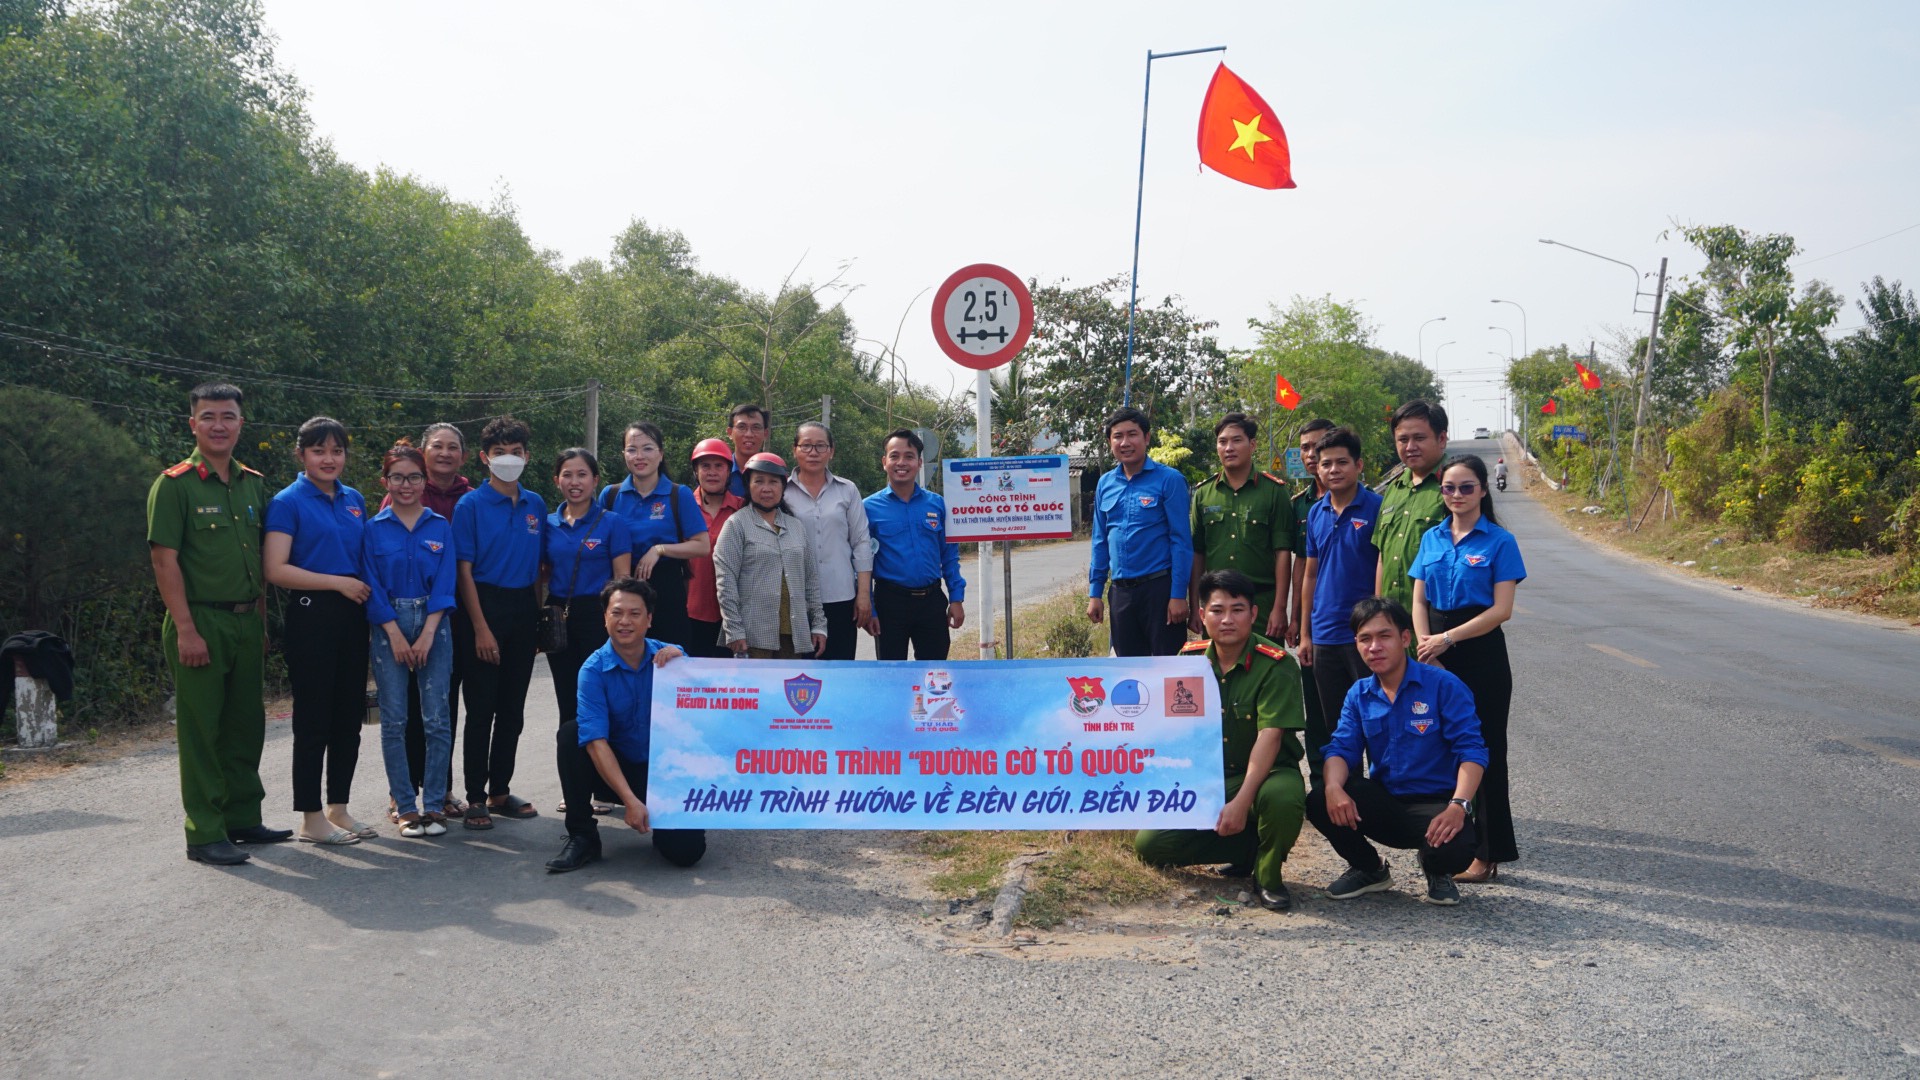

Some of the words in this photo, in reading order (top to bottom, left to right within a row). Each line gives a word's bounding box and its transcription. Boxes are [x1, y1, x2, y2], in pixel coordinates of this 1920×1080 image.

[979, 494, 1006, 503] CÔNG
[1010, 492, 1036, 501] TRÌNH
[952, 504, 992, 514] ĐƯỜNG
[997, 504, 1011, 513] CỜ
[1015, 502, 1028, 512] TỔ
[1033, 501, 1063, 511] QUỐC
[676, 697, 707, 709] NGƯỜI
[710, 698, 729, 710] LAO
[732, 698, 758, 710] ĐỘNG
[1084, 722, 1101, 731] TỈNH
[1104, 720, 1118, 731] BẾN
[1121, 722, 1134, 731] TRE
[736, 748, 827, 775] CHƯƠNG
[836, 747, 901, 775] TRÌNH
[1006, 746, 1037, 775] CỜ
[1044, 742, 1073, 775] TỔ
[683, 784, 752, 813] HÀNH
[760, 786, 830, 814] TRÌNH
[835, 786, 918, 814] HƯỚNG
[924, 782, 953, 814] VỀ
[956, 786, 1016, 814] BIÊN
[1079, 780, 1140, 813] BIỂN
[1147, 782, 1197, 813] ĐẢO
